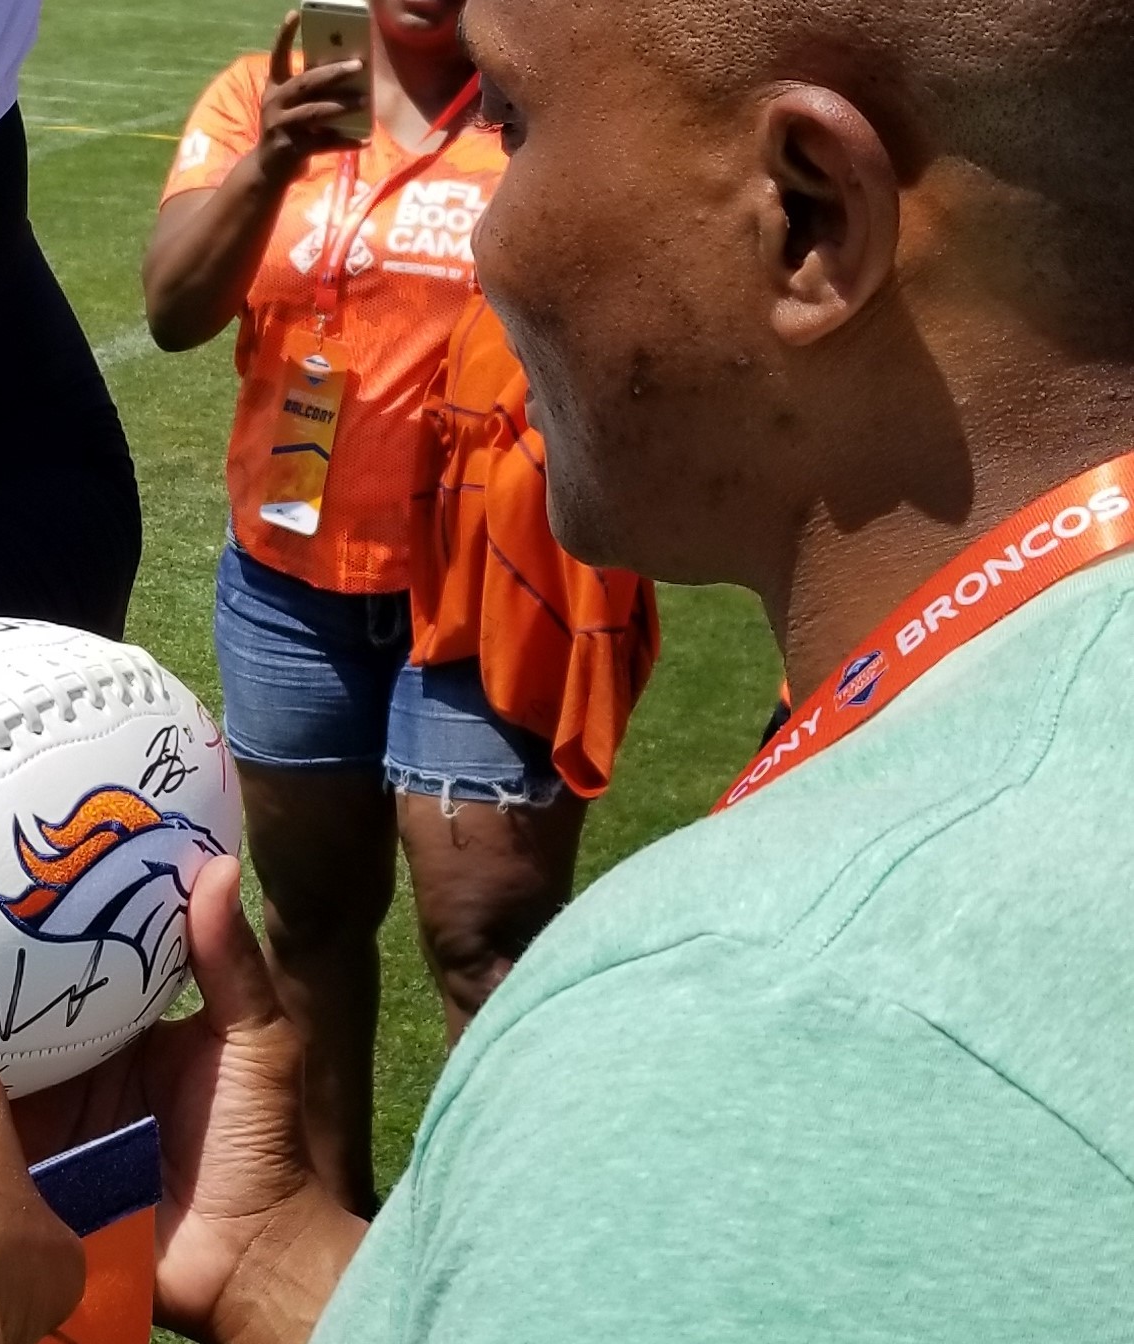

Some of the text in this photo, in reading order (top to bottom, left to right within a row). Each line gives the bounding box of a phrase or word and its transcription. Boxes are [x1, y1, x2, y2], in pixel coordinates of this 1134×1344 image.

[401, 180, 487, 211] NFL
[387, 226, 475, 262] CAM
[894, 486, 1130, 657] BRONCOS
